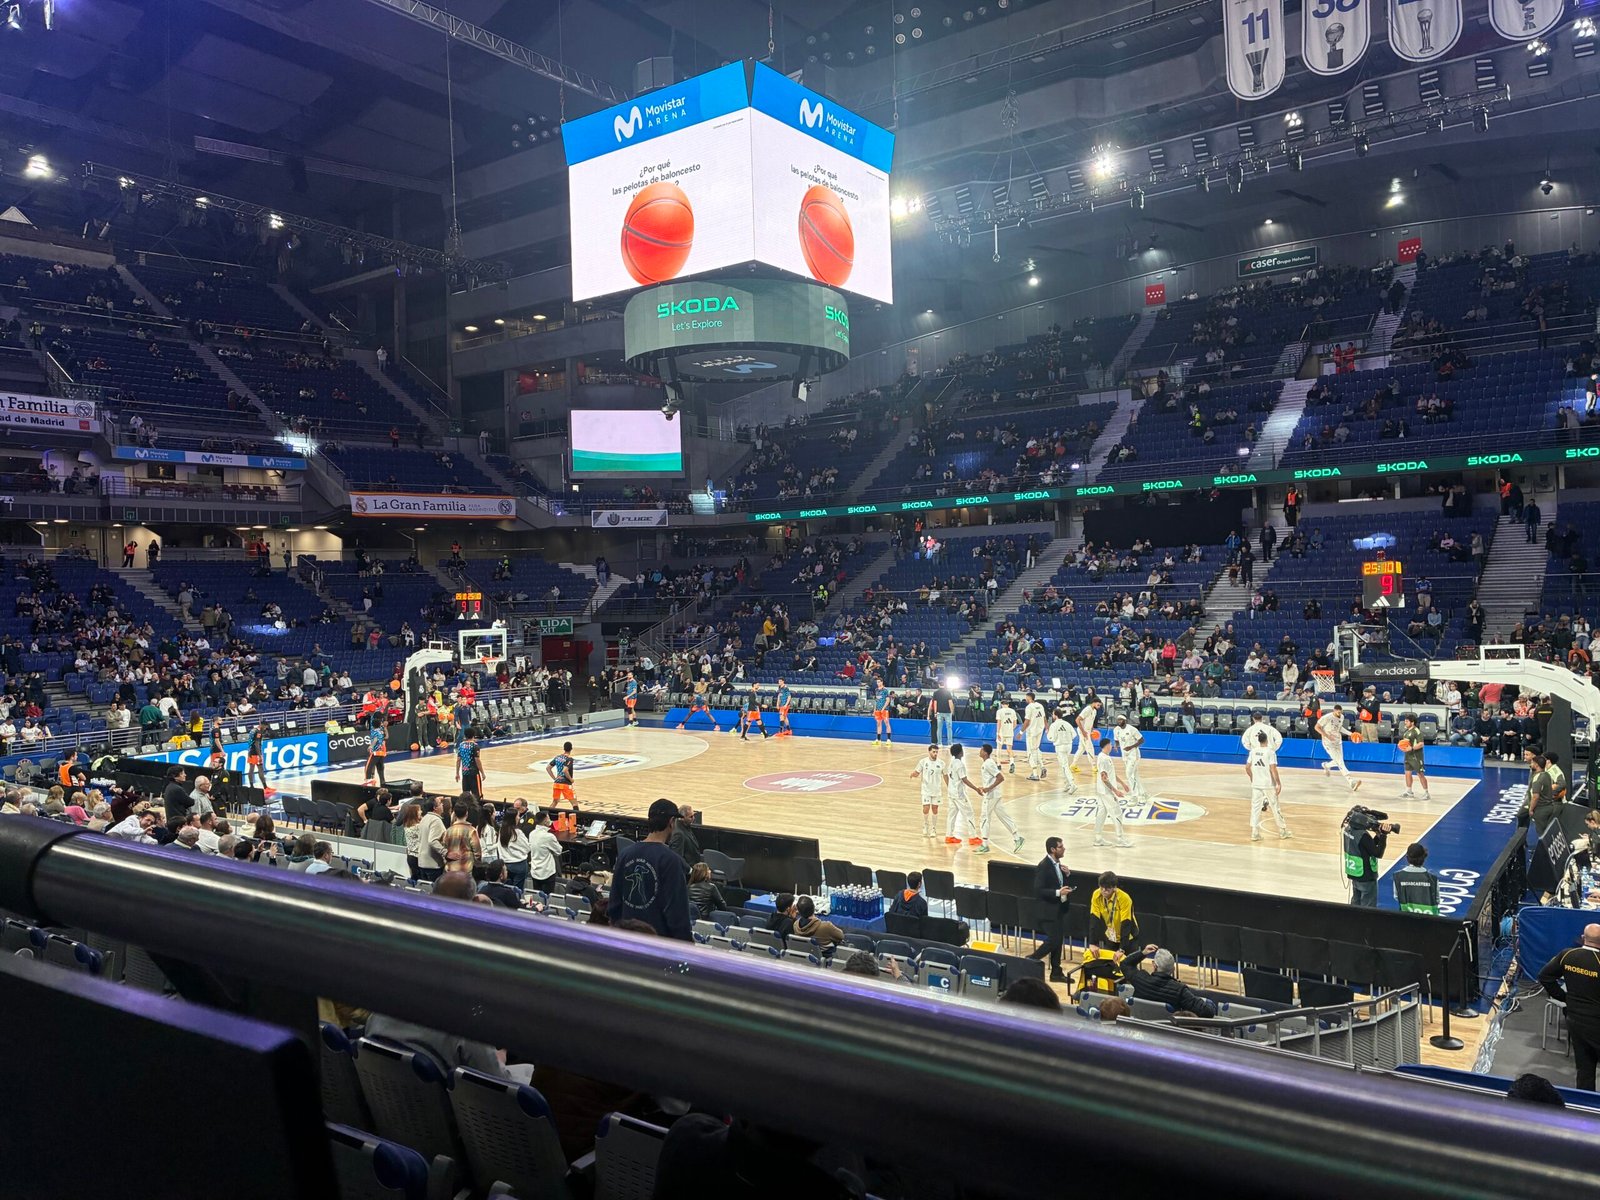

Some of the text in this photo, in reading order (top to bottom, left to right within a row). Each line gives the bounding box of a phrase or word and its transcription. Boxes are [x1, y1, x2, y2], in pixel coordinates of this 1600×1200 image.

[1241, 8, 1270, 44] 11
[645, 97, 686, 117] Movistar
[648, 109, 687, 128] ARENA
[826, 112, 857, 136] Movistar
[825, 126, 854, 145] ARENA
[639, 159, 671, 178] ¿Por qué
[814, 164, 838, 181] ¿Por qué
[612, 187, 622, 196] las
[623, 180, 649, 194] pelotas
[650, 175, 659, 184] de
[660, 163, 701, 181] baloncesto
[791, 164, 799, 175] las
[800, 170, 821, 184] pelotas
[822, 179, 830, 188] de
[830, 182, 859, 200] baloncesto
[1251, 257, 1277, 269] caser
[672, 319, 723, 331] Let's Explore
[825, 305, 849, 330] SKO
[8, 396, 69, 414] Familia
[14, 415, 27, 423] de
[30, 417, 65, 426] Madrid
[373, 500, 467, 512] La Gran Familia
[1381, 575, 1393, 595] 9
[474, 601, 481, 612] 9
[540, 619, 569, 627] LIDA
[1374, 666, 1417, 675] endesa
[328, 734, 371, 750] endes
[178, 740, 319, 773] Sntas
[1061, 806, 1143, 819] RLE
[1564, 964, 1598, 978] PROSEGUR
[940, 977, 949, 988] C
